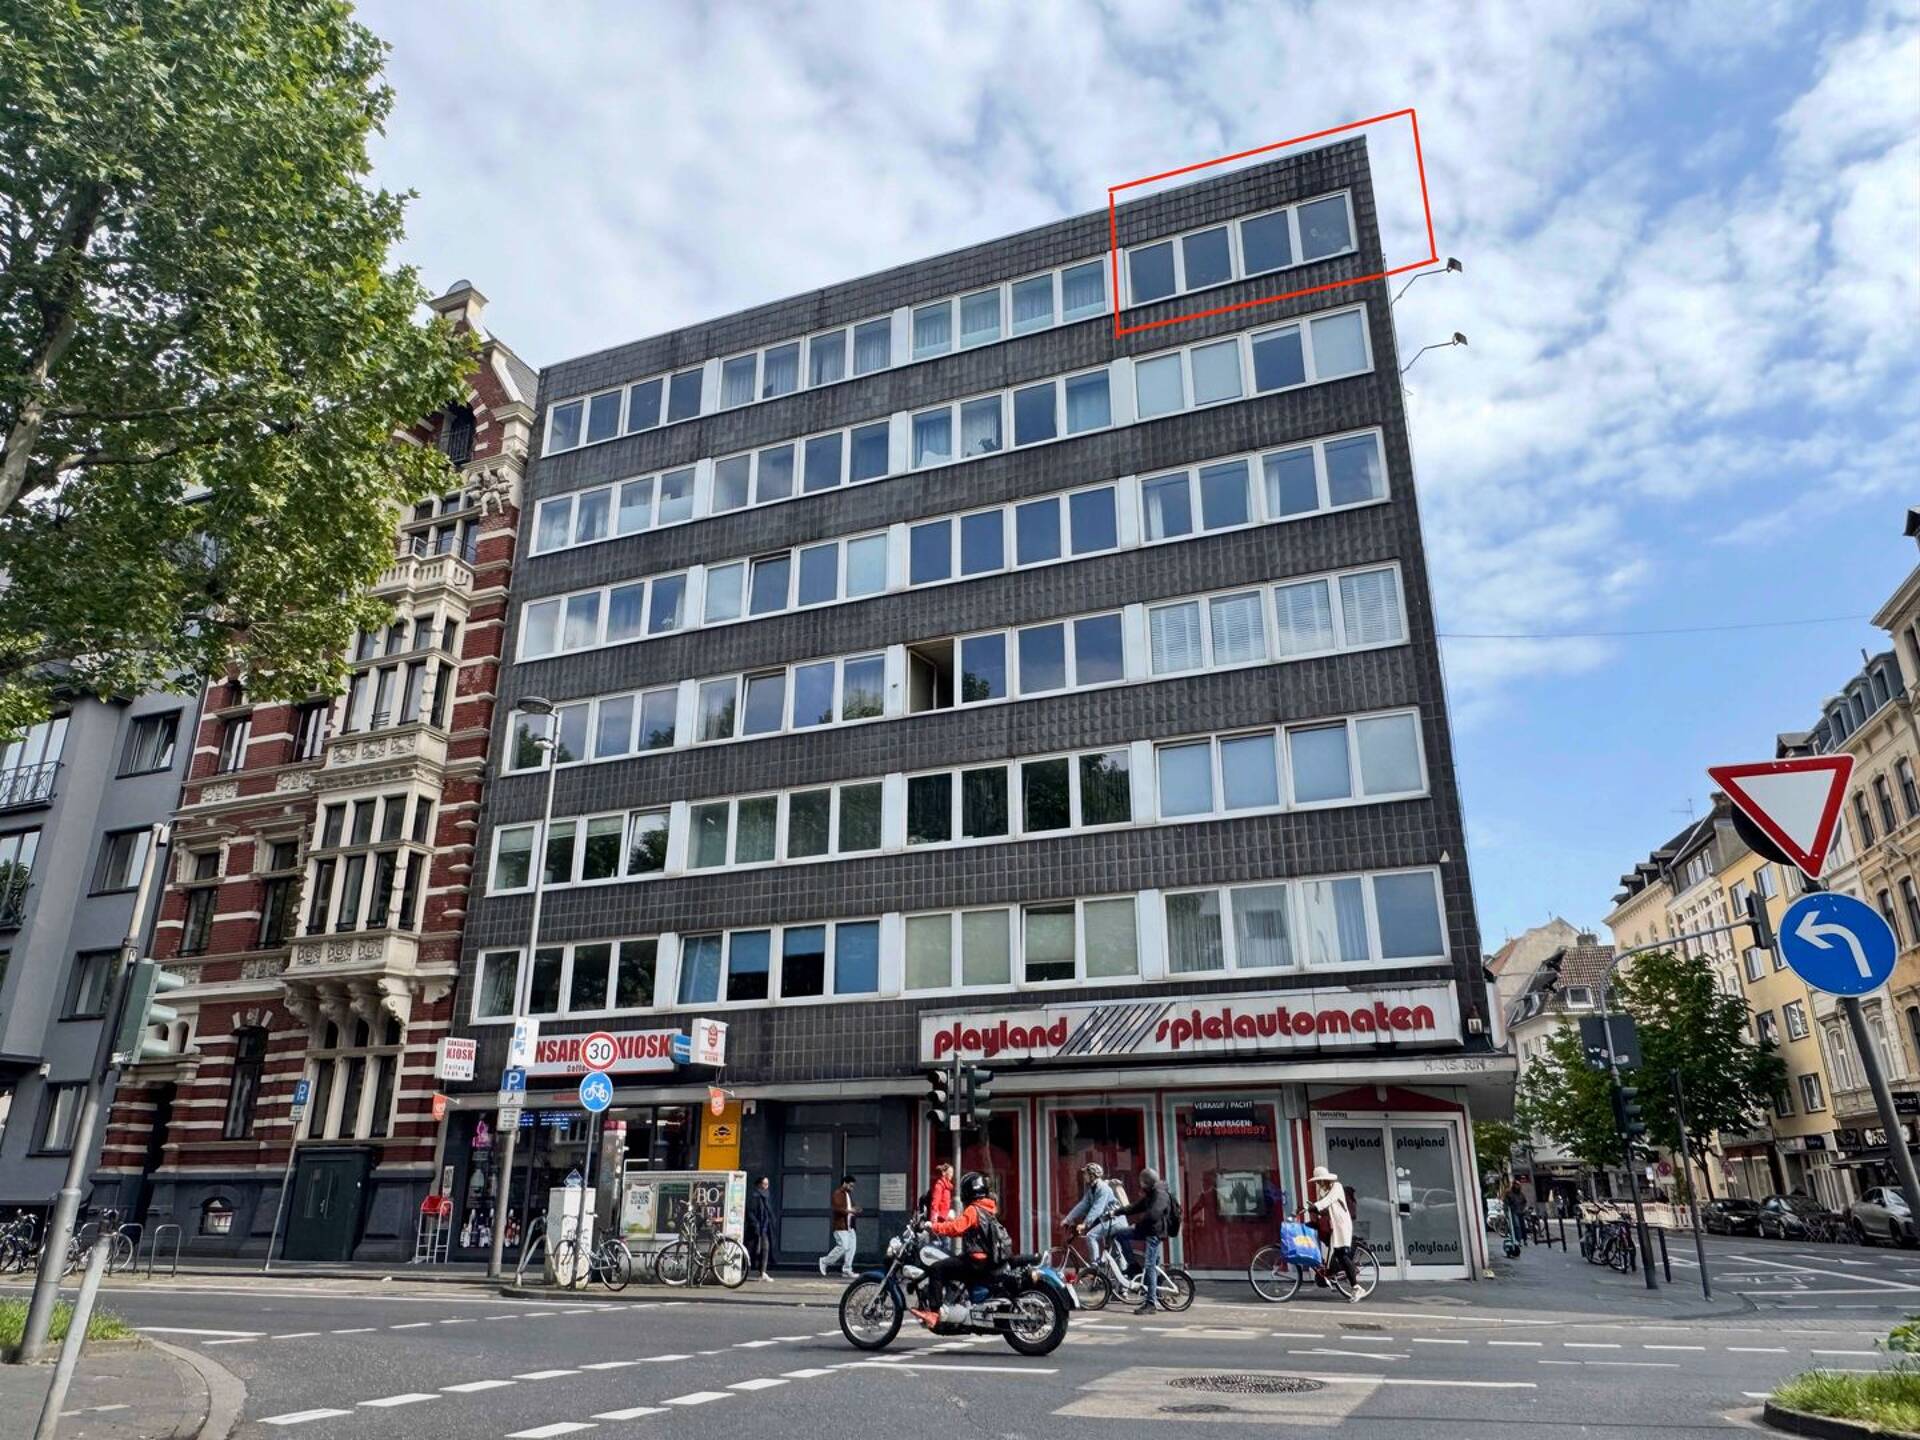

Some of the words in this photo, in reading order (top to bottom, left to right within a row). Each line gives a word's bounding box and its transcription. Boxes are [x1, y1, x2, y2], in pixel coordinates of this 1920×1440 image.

[934, 1016, 1068, 1060] playland
[1155, 1001, 1436, 1050] spielautomaten
[446, 1047, 474, 1061] KIOSK
[588, 1043, 611, 1060] 30
[616, 1034, 670, 1060] KIOSK
[1328, 1136, 1381, 1150] playland
[1396, 1136, 1446, 1149] playland
[1408, 1241, 1458, 1255] playland
